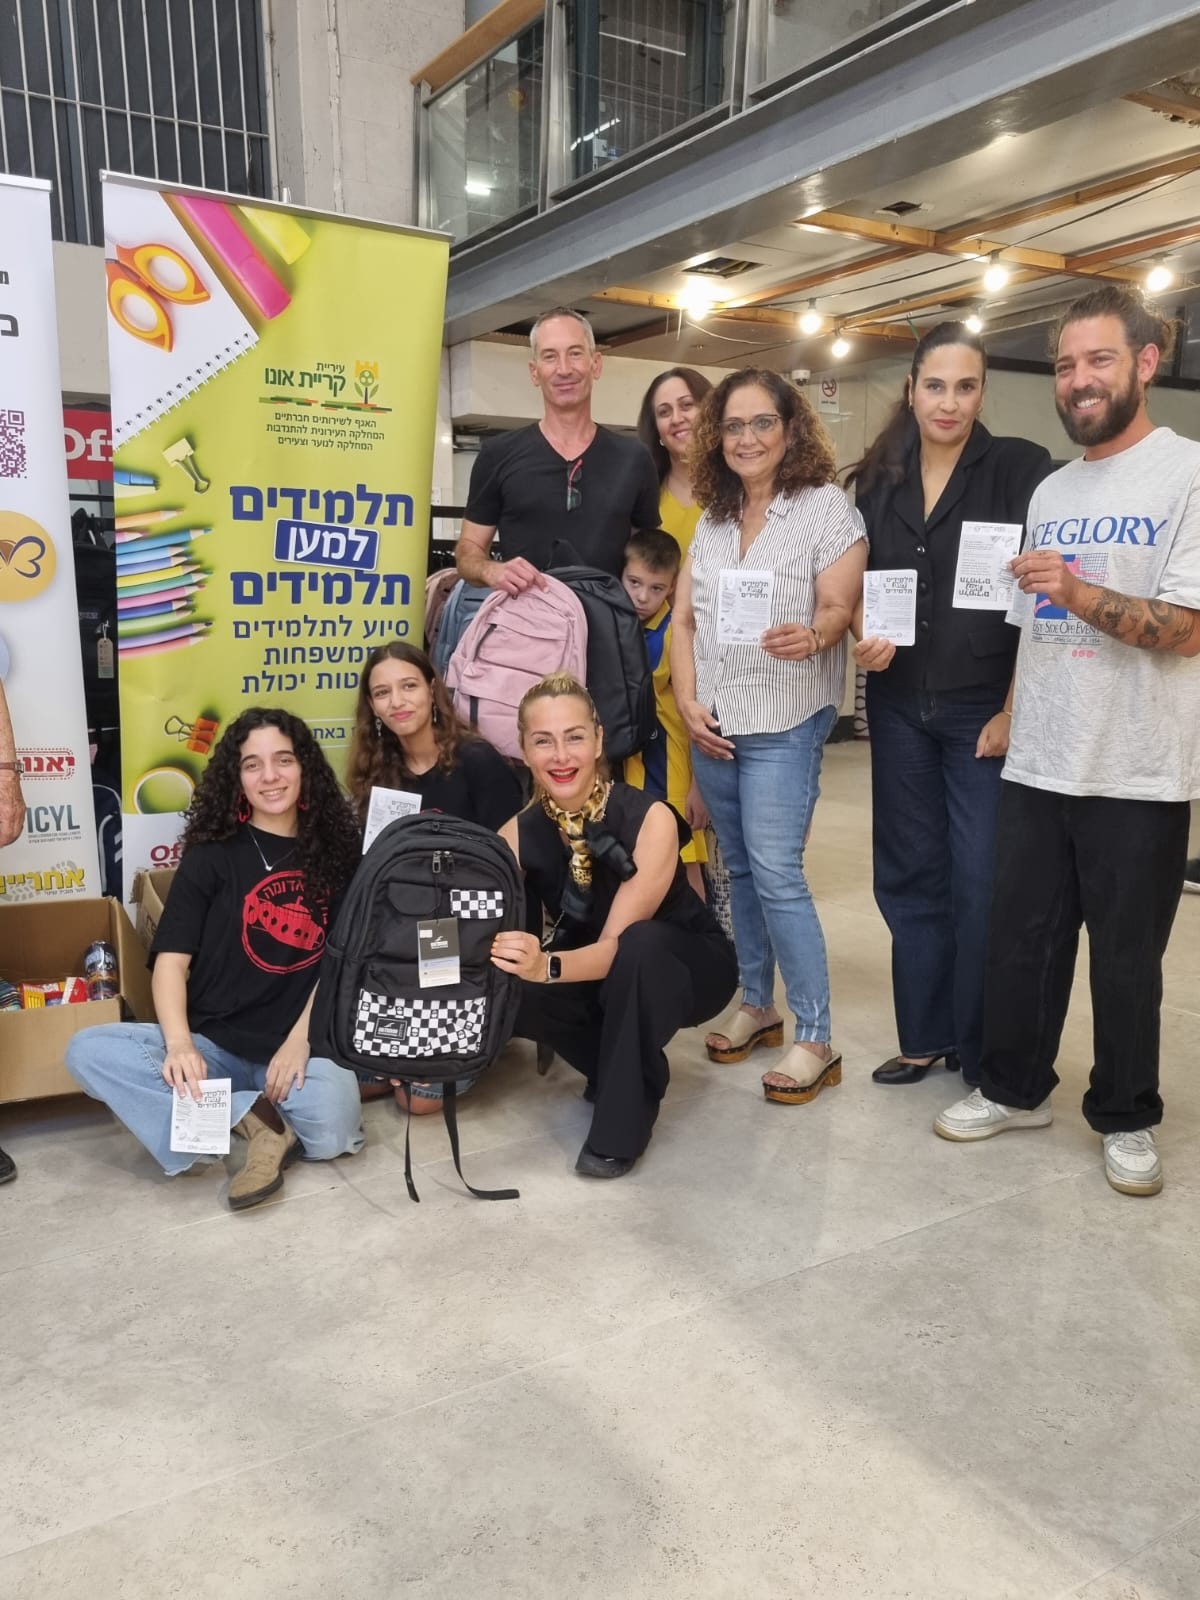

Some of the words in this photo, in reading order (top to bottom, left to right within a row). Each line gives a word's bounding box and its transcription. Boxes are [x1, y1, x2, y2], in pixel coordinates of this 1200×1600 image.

[316, 362, 345, 374] עיריית
[265, 367, 295, 387] אונו
[298, 371, 346, 397] קריית
[275, 412, 309, 423] חברתיים
[312, 415, 352, 426] לשירותים
[266, 423, 308, 434] להתנדבות
[311, 427, 347, 438] העירונית
[349, 430, 385, 441] המחלקה
[278, 436, 309, 446] וצעירים
[311, 438, 334, 448] לנוער
[337, 440, 373, 451] המחלקה
[229, 483, 414, 527] תלמידים
[287, 526, 369, 562] למען
[229, 569, 411, 605] תלמידים
[232, 614, 353, 639] לתלמידים
[362, 619, 410, 639] סיוע
[241, 670, 306, 694] יכולת
[315, 672, 359, 690] טות
[313, 727, 347, 740] באת
[26, 804, 81, 834] ICYL
